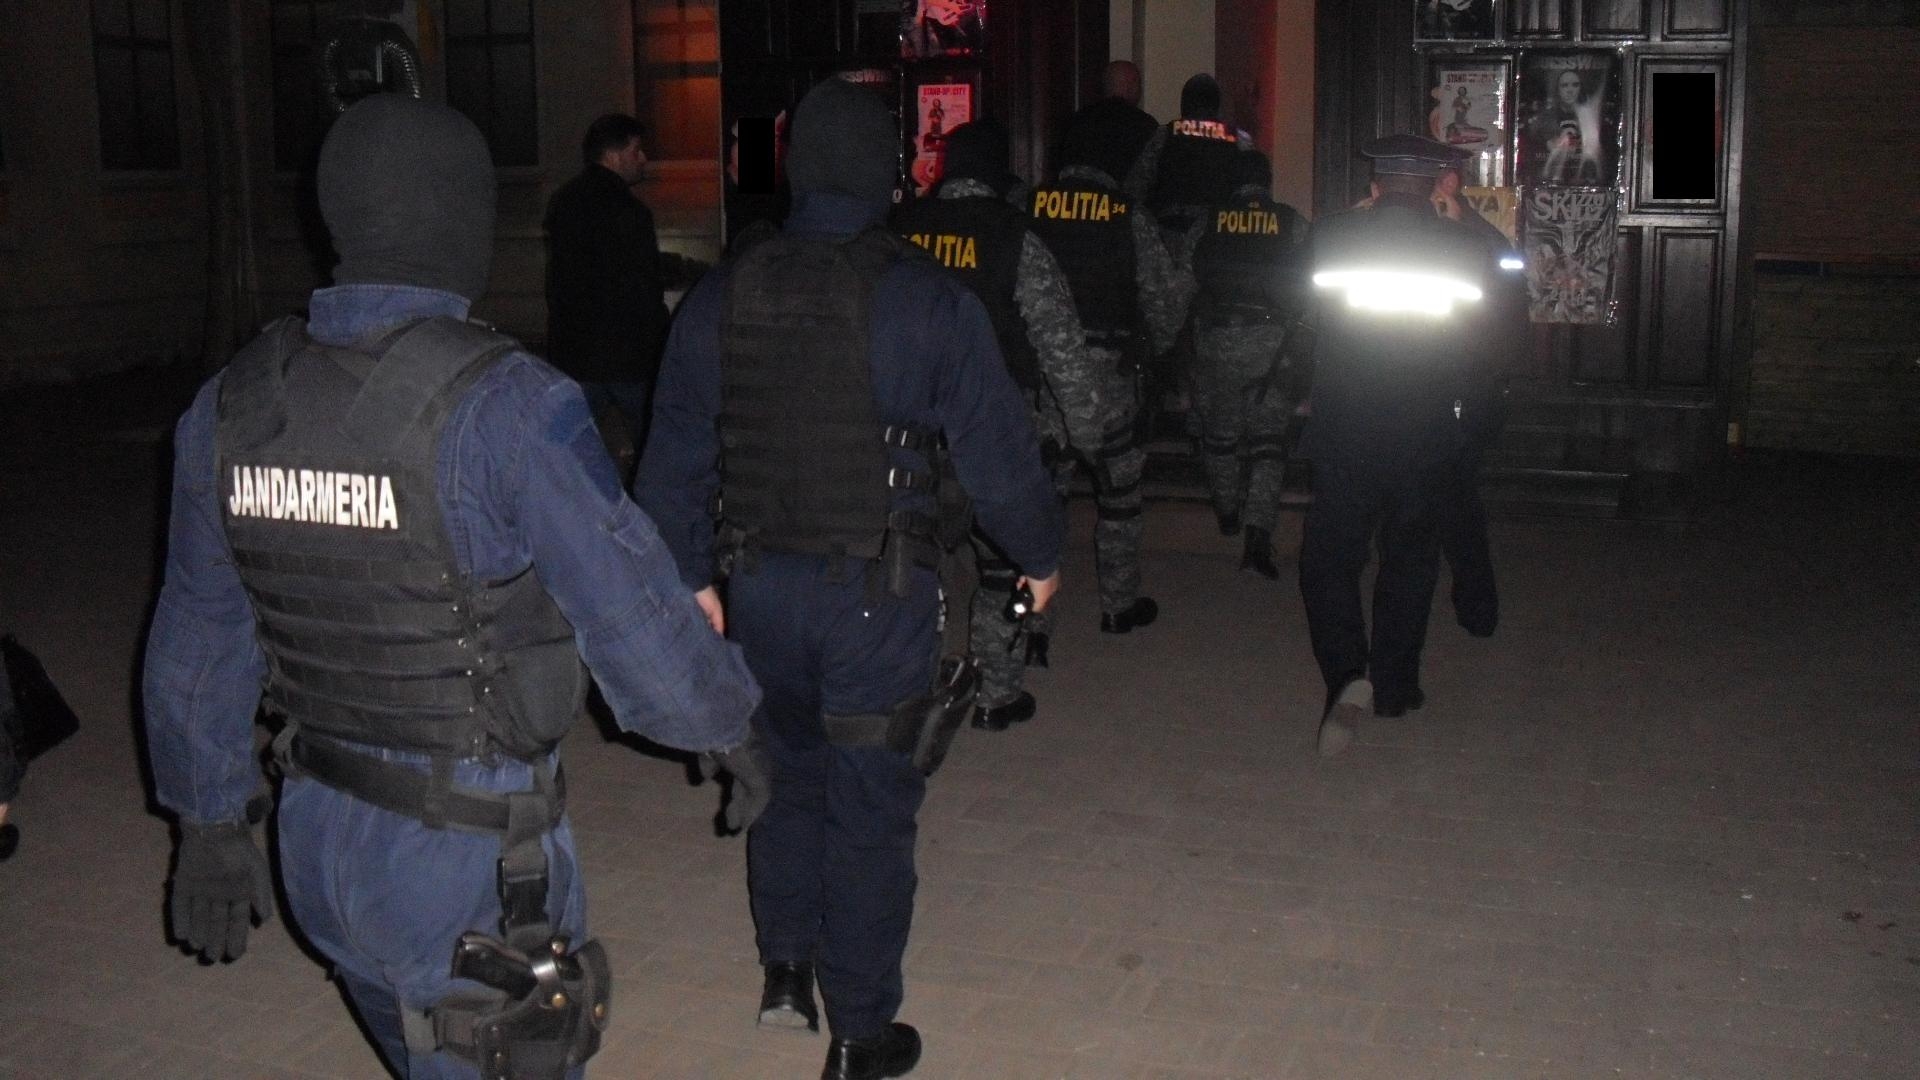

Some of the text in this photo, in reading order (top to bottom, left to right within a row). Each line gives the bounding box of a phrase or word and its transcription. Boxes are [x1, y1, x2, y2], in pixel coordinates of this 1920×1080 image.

[1173, 119, 1226, 139] POLITIA
[1033, 190, 1127, 221] POLITIA 34
[1217, 210, 1279, 235] POLITIA
[902, 233, 977, 269] ITIA
[229, 465, 399, 530] JANDARMERIA
